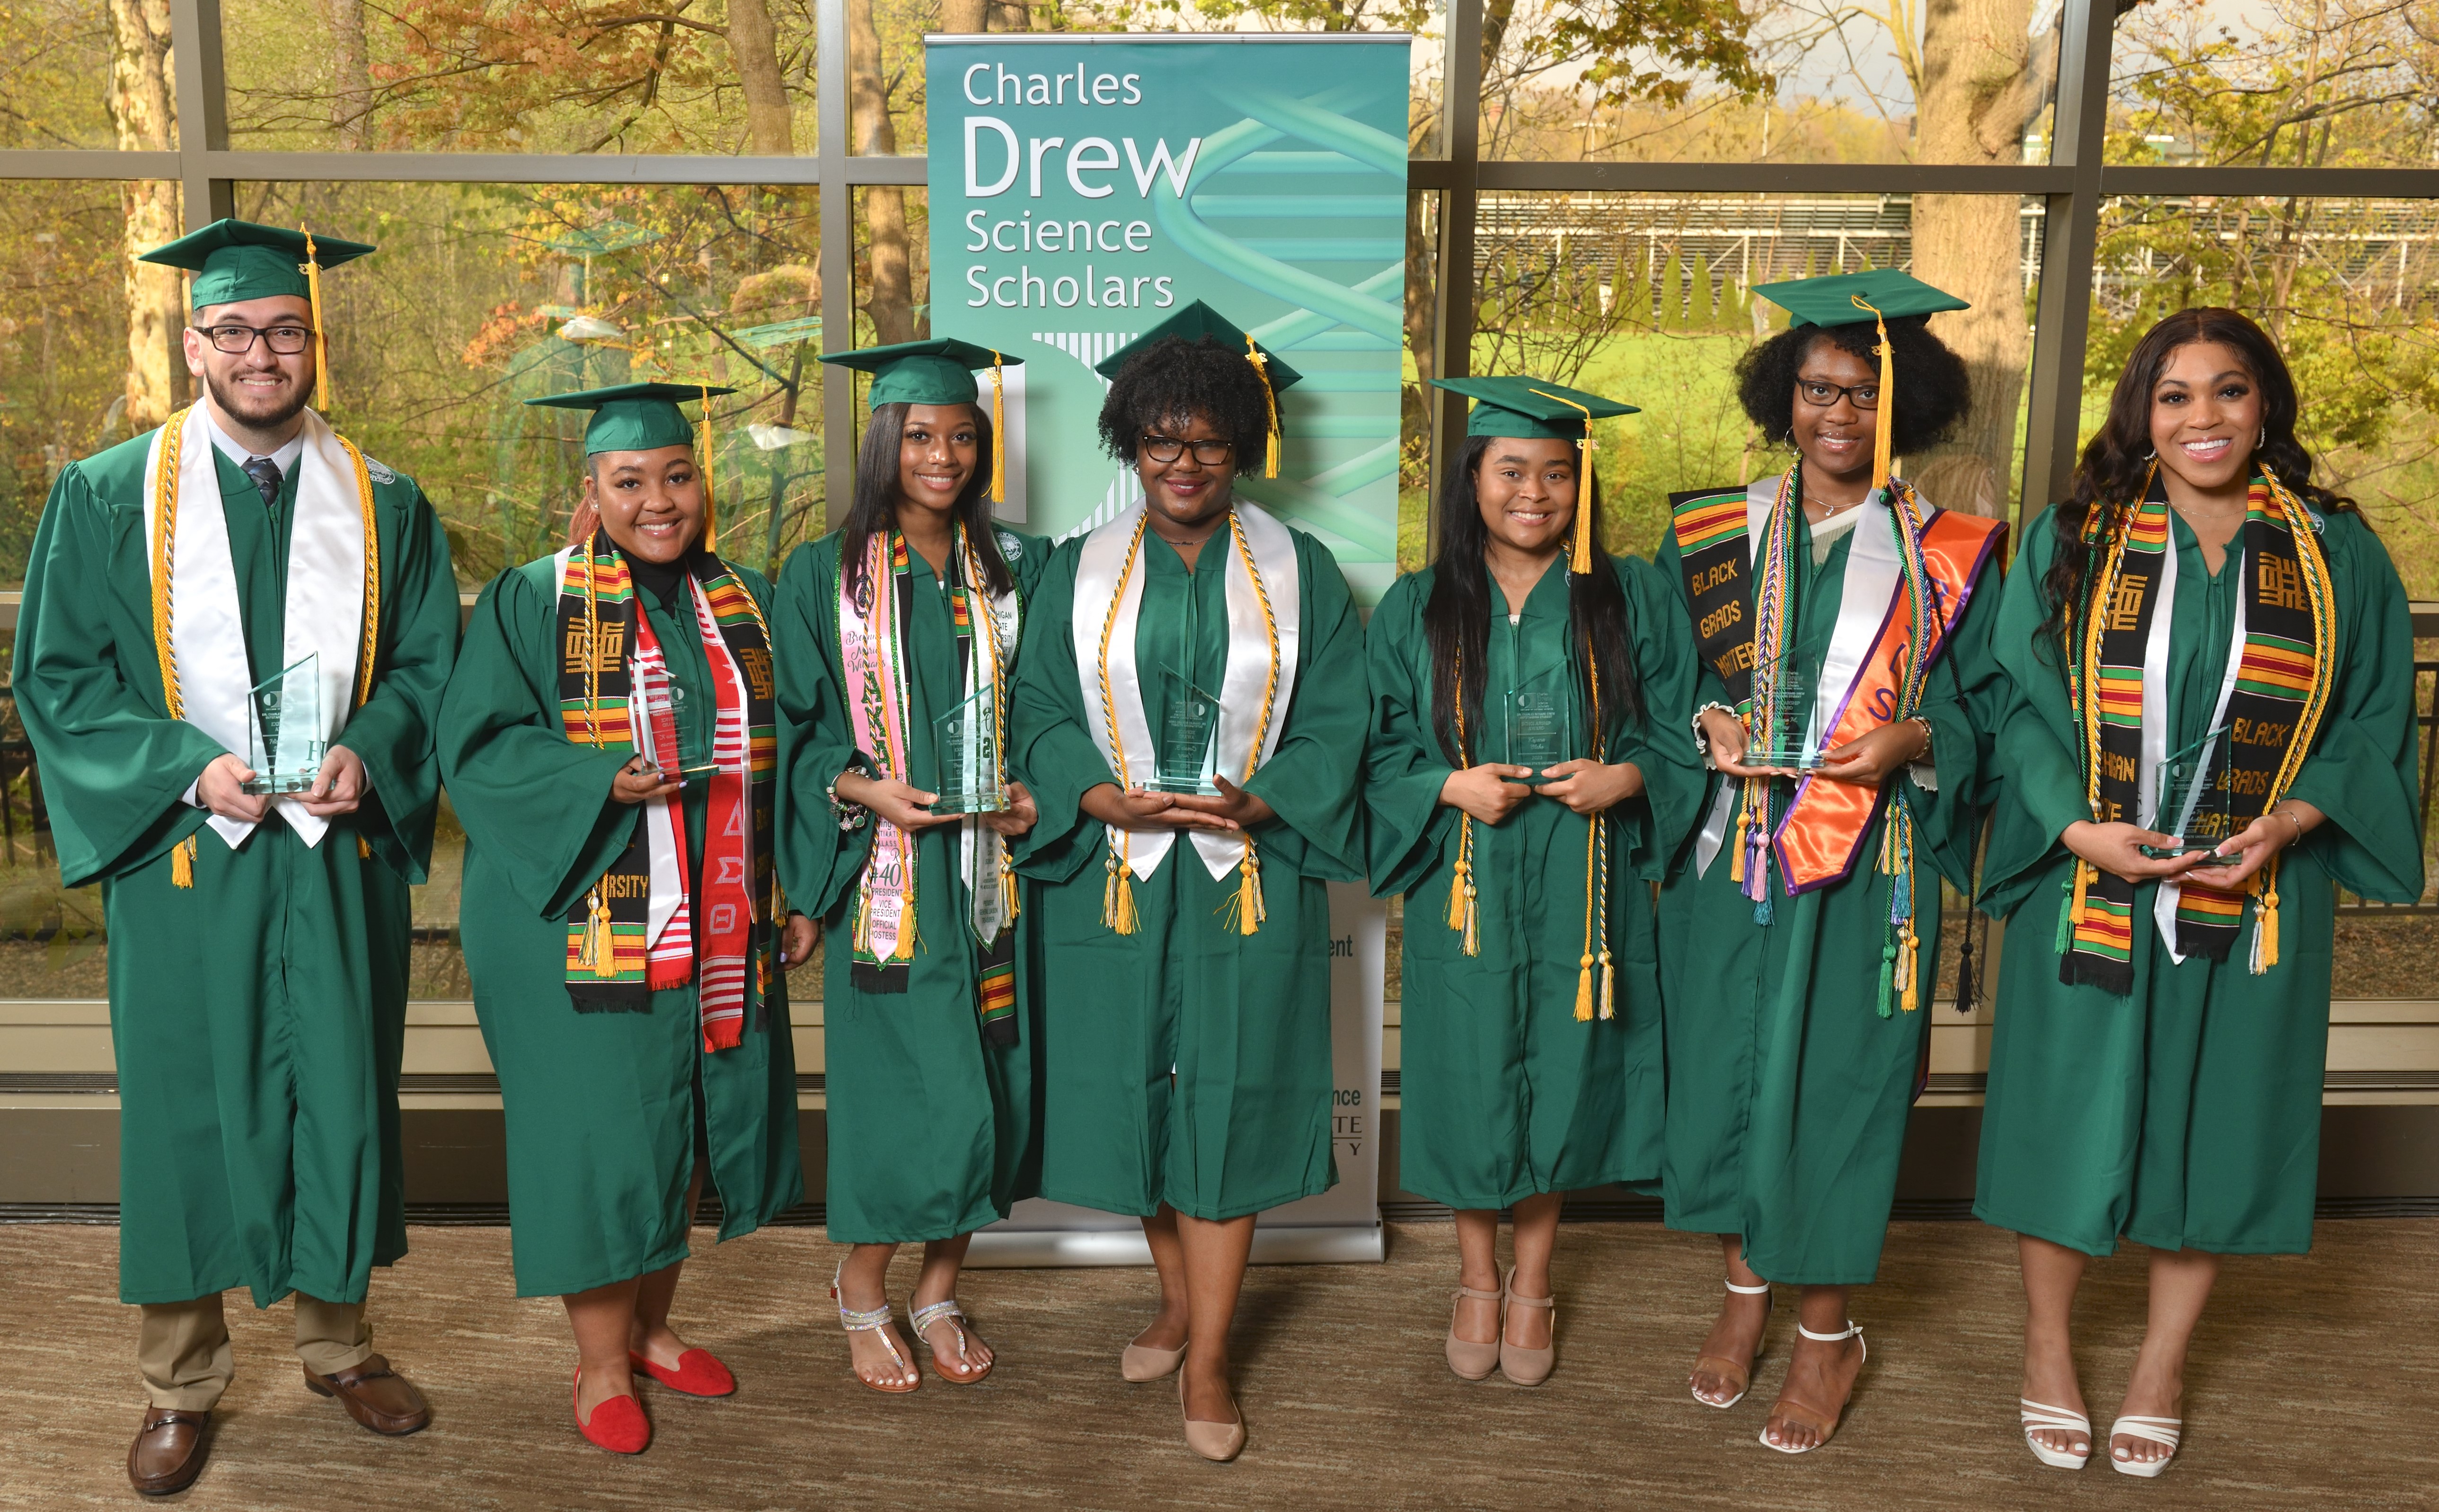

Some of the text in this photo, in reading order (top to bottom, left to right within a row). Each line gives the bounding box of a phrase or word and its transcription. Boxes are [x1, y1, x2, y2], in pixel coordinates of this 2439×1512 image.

[963, 62, 1142, 105] Charles
[963, 116, 1202, 199] Drew
[966, 209, 1153, 252] Science
[967, 265, 1175, 308] Scholars
[1692, 558, 1738, 596] BLACK
[1700, 600, 1741, 639] GRADS
[2231, 717, 2290, 747] BLACK
[2216, 769, 2269, 795] GRADS
[871, 888, 903, 897] PRESIDENT
[879, 900, 891, 908] VICE
[871, 909, 901, 917] PRESIDENT
[872, 920, 896, 930] OFFICIAL
